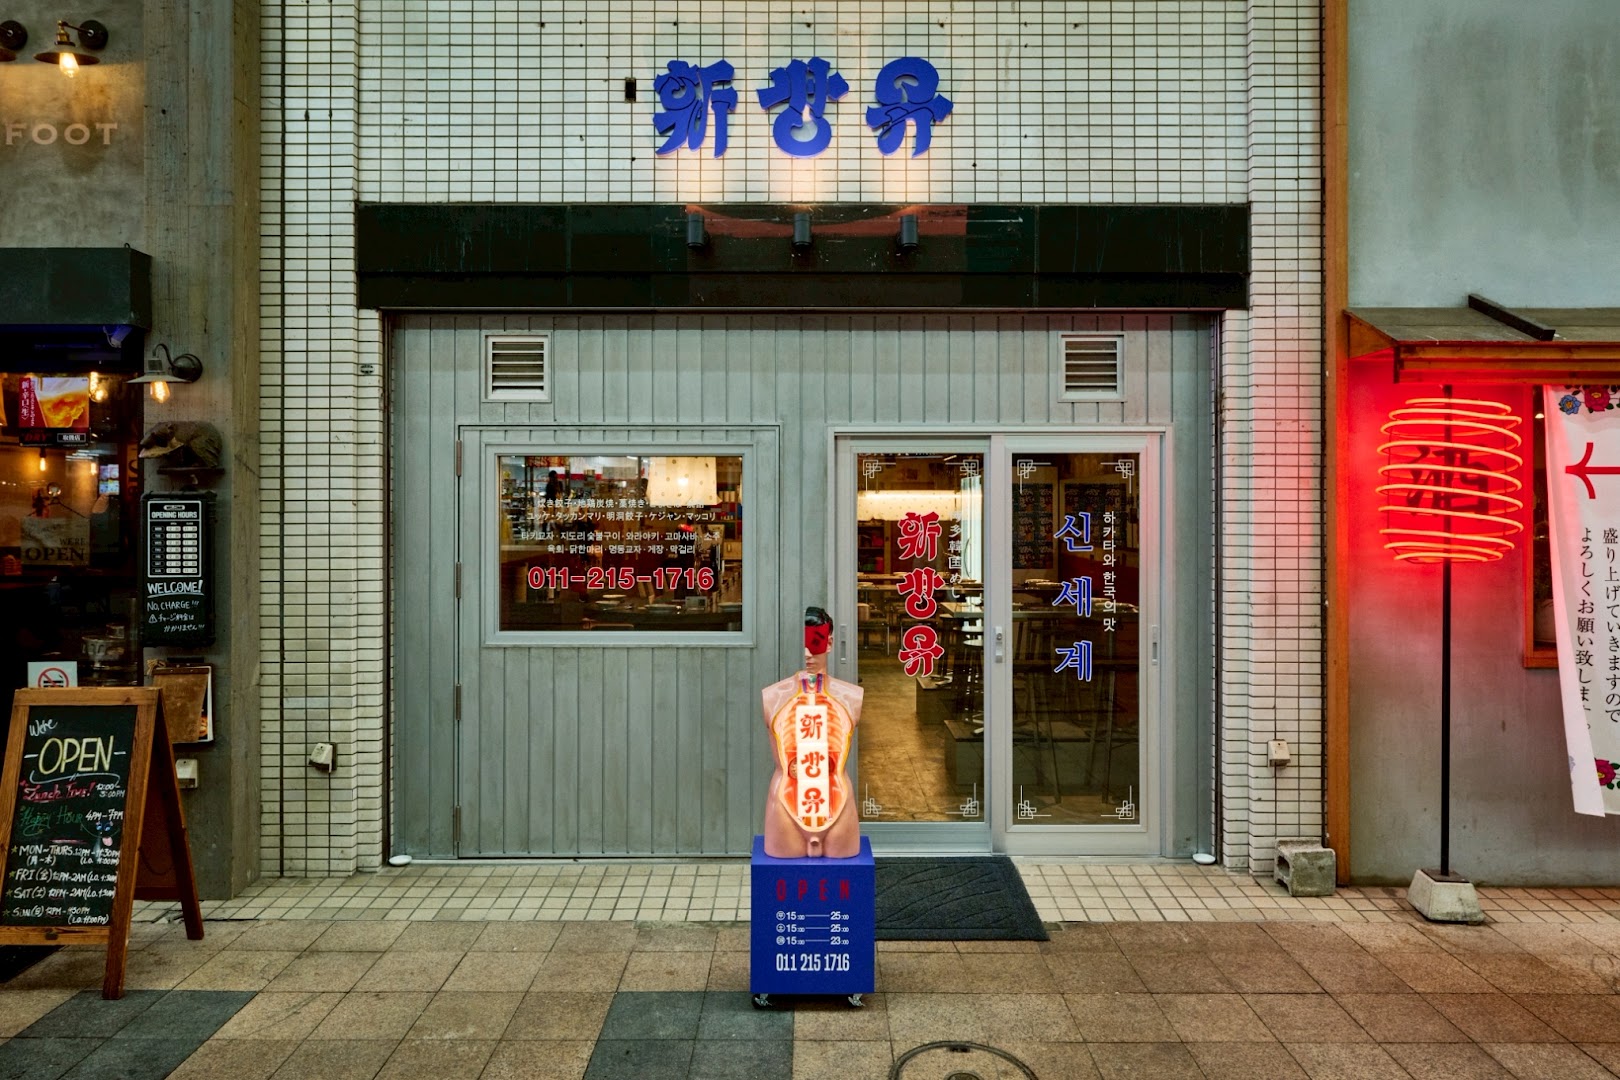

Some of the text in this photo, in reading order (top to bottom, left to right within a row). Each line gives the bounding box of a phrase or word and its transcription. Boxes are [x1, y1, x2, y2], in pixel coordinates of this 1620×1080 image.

[5, 122, 118, 146] FOOT
[151, 511, 198, 519] OPENING HOURS
[560, 530, 586, 542] 지도리
[25, 547, 85, 561] OPEN
[527, 566, 715, 591] 011-215-1716
[1102, 511, 1117, 632] 하카타와 한국의 맛
[147, 580, 203, 594] WELCOME!
[1051, 511, 1094, 682] 신세계
[38, 735, 114, 775] OPEN
[15, 868, 36, 882] FRI
[776, 878, 850, 901] OPEN
[776, 953, 850, 971] 011 215 1716
